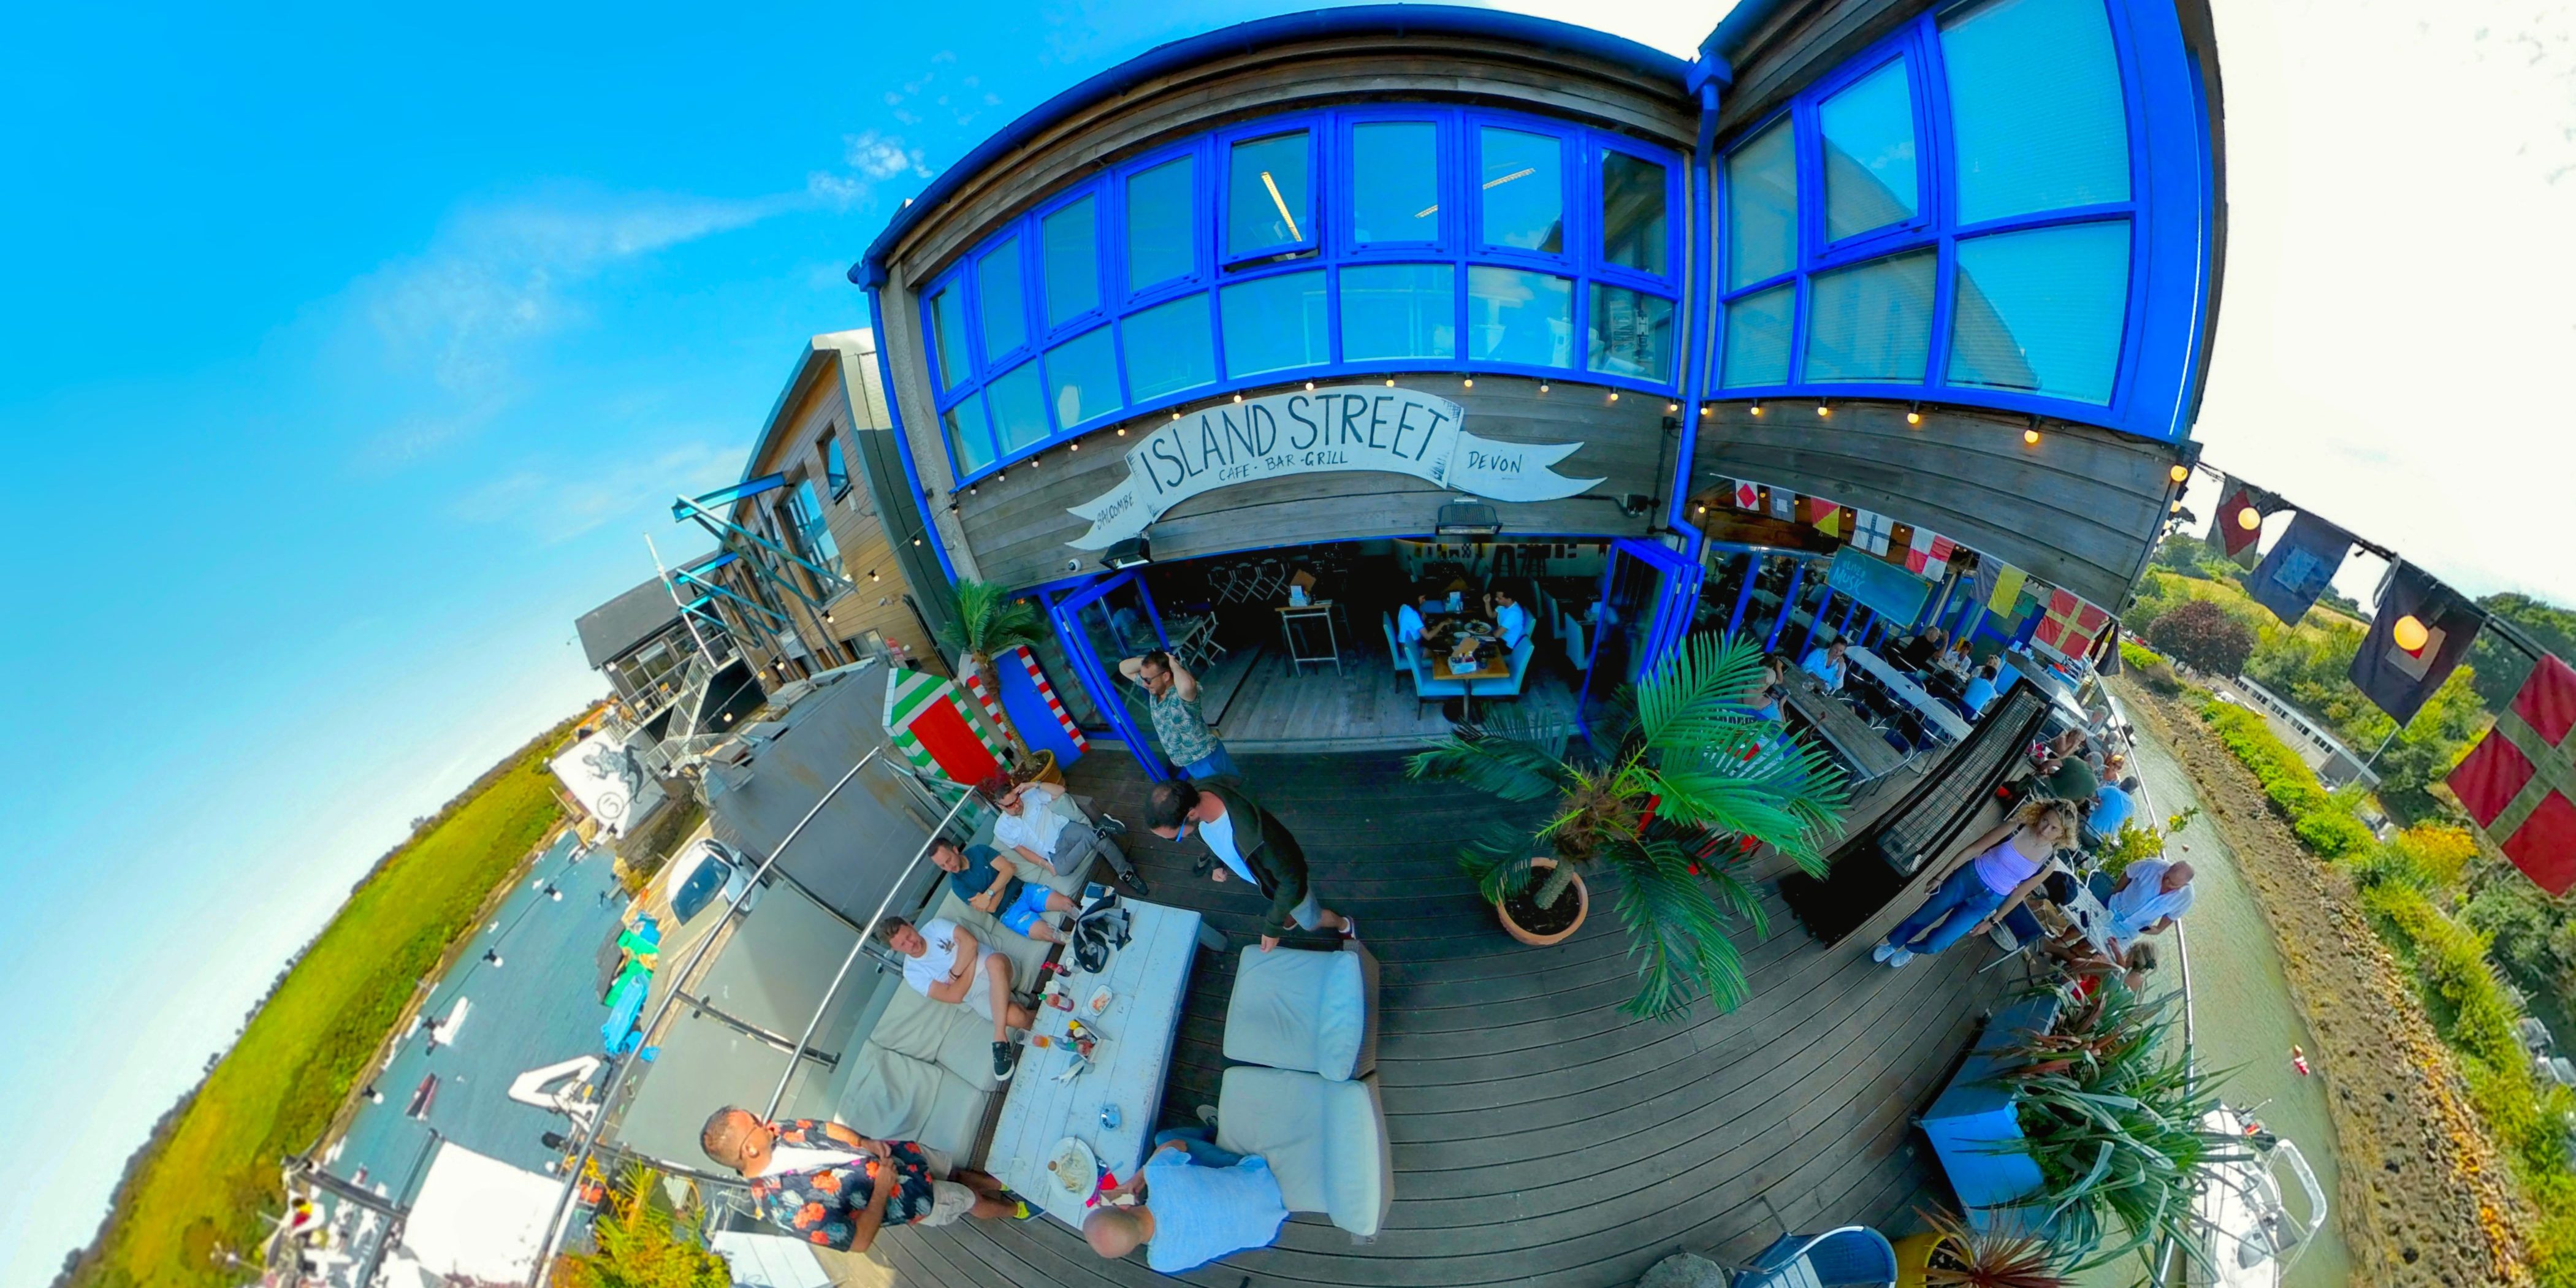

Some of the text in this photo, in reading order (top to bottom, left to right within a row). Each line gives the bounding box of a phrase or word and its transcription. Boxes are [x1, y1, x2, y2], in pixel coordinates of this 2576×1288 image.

[1140, 394, 1450, 495] ISLAND STREET
[1219, 463, 1250, 481] CAFE
[1265, 454, 1294, 471] BAR
[1467, 451, 1523, 473] DEVON
[1097, 490, 1134, 531] SALCOMBE
[1832, 566, 1865, 596] MUSIC
[1846, 560, 1862, 576] LIVE
